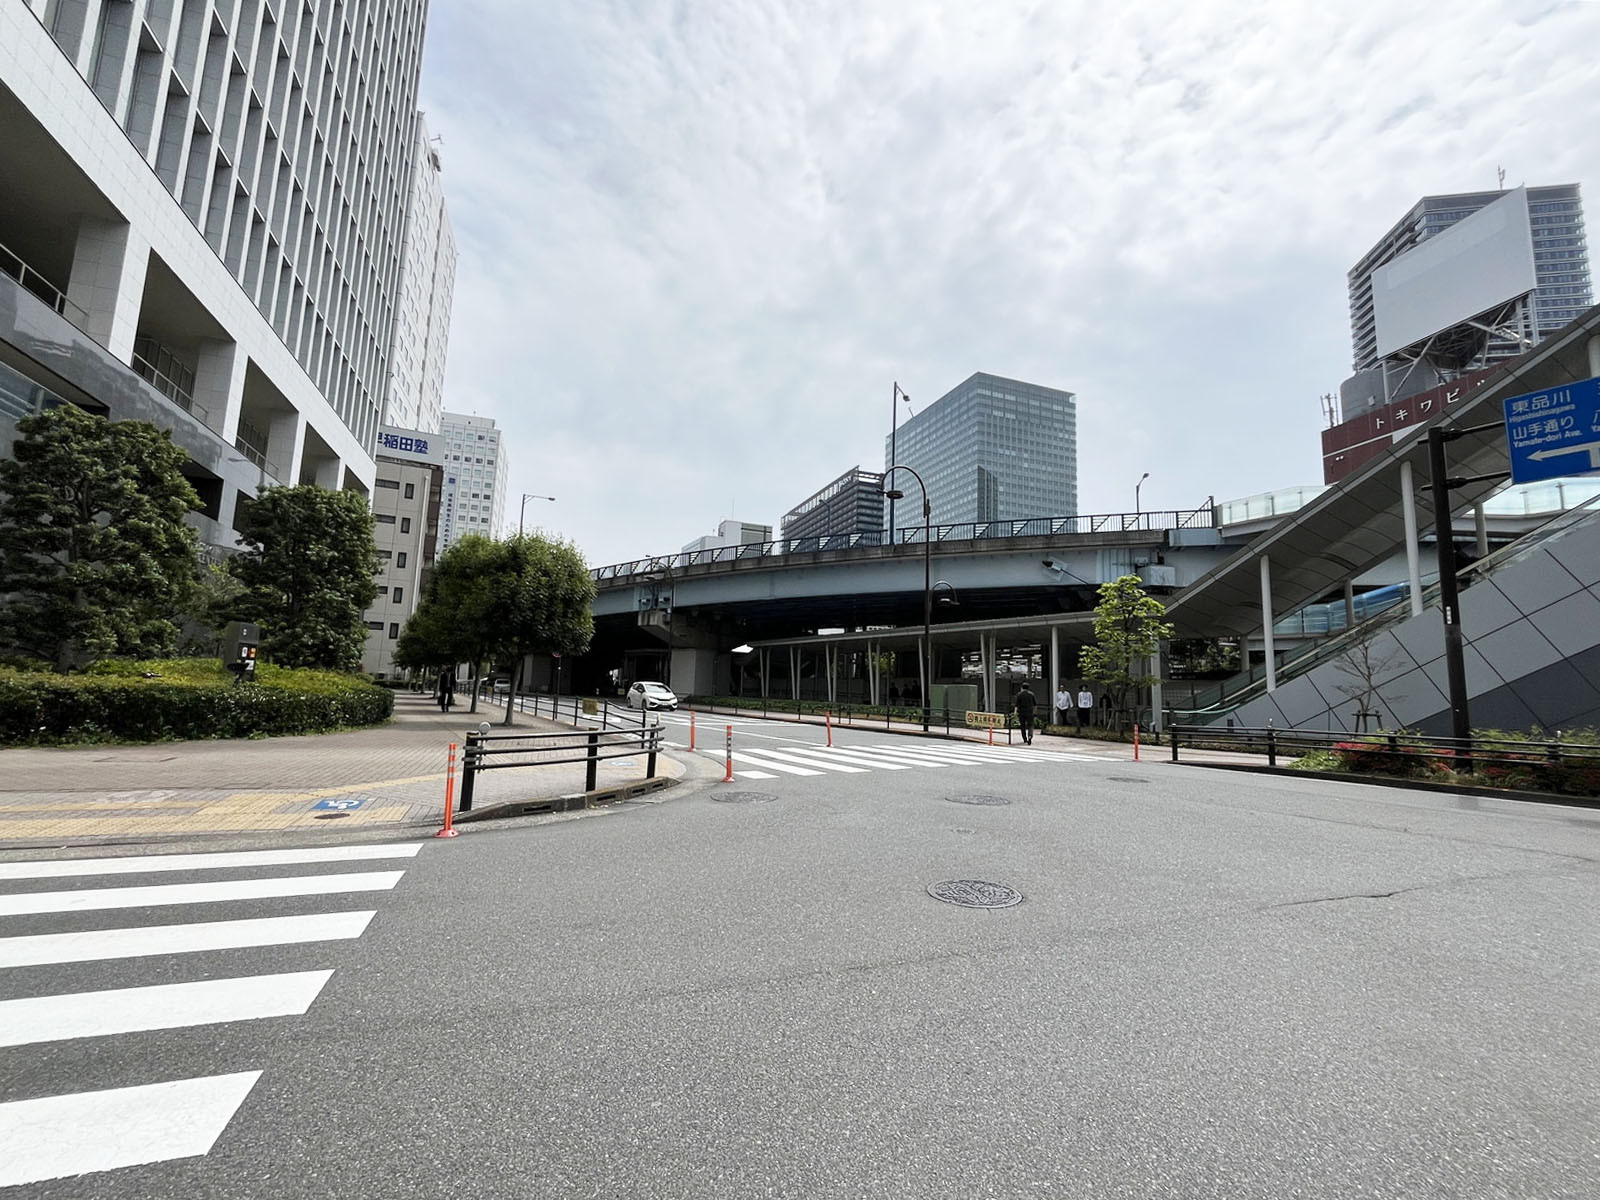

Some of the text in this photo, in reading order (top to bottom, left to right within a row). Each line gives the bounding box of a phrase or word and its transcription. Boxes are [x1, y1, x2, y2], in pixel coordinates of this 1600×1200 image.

[1375, 380, 1485, 430] トキワビ
[1511, 389, 1571, 415] 東品川
[1513, 416, 1574, 440] 山手通り
[1513, 430, 1583, 448] Yamate-dori Ave.
